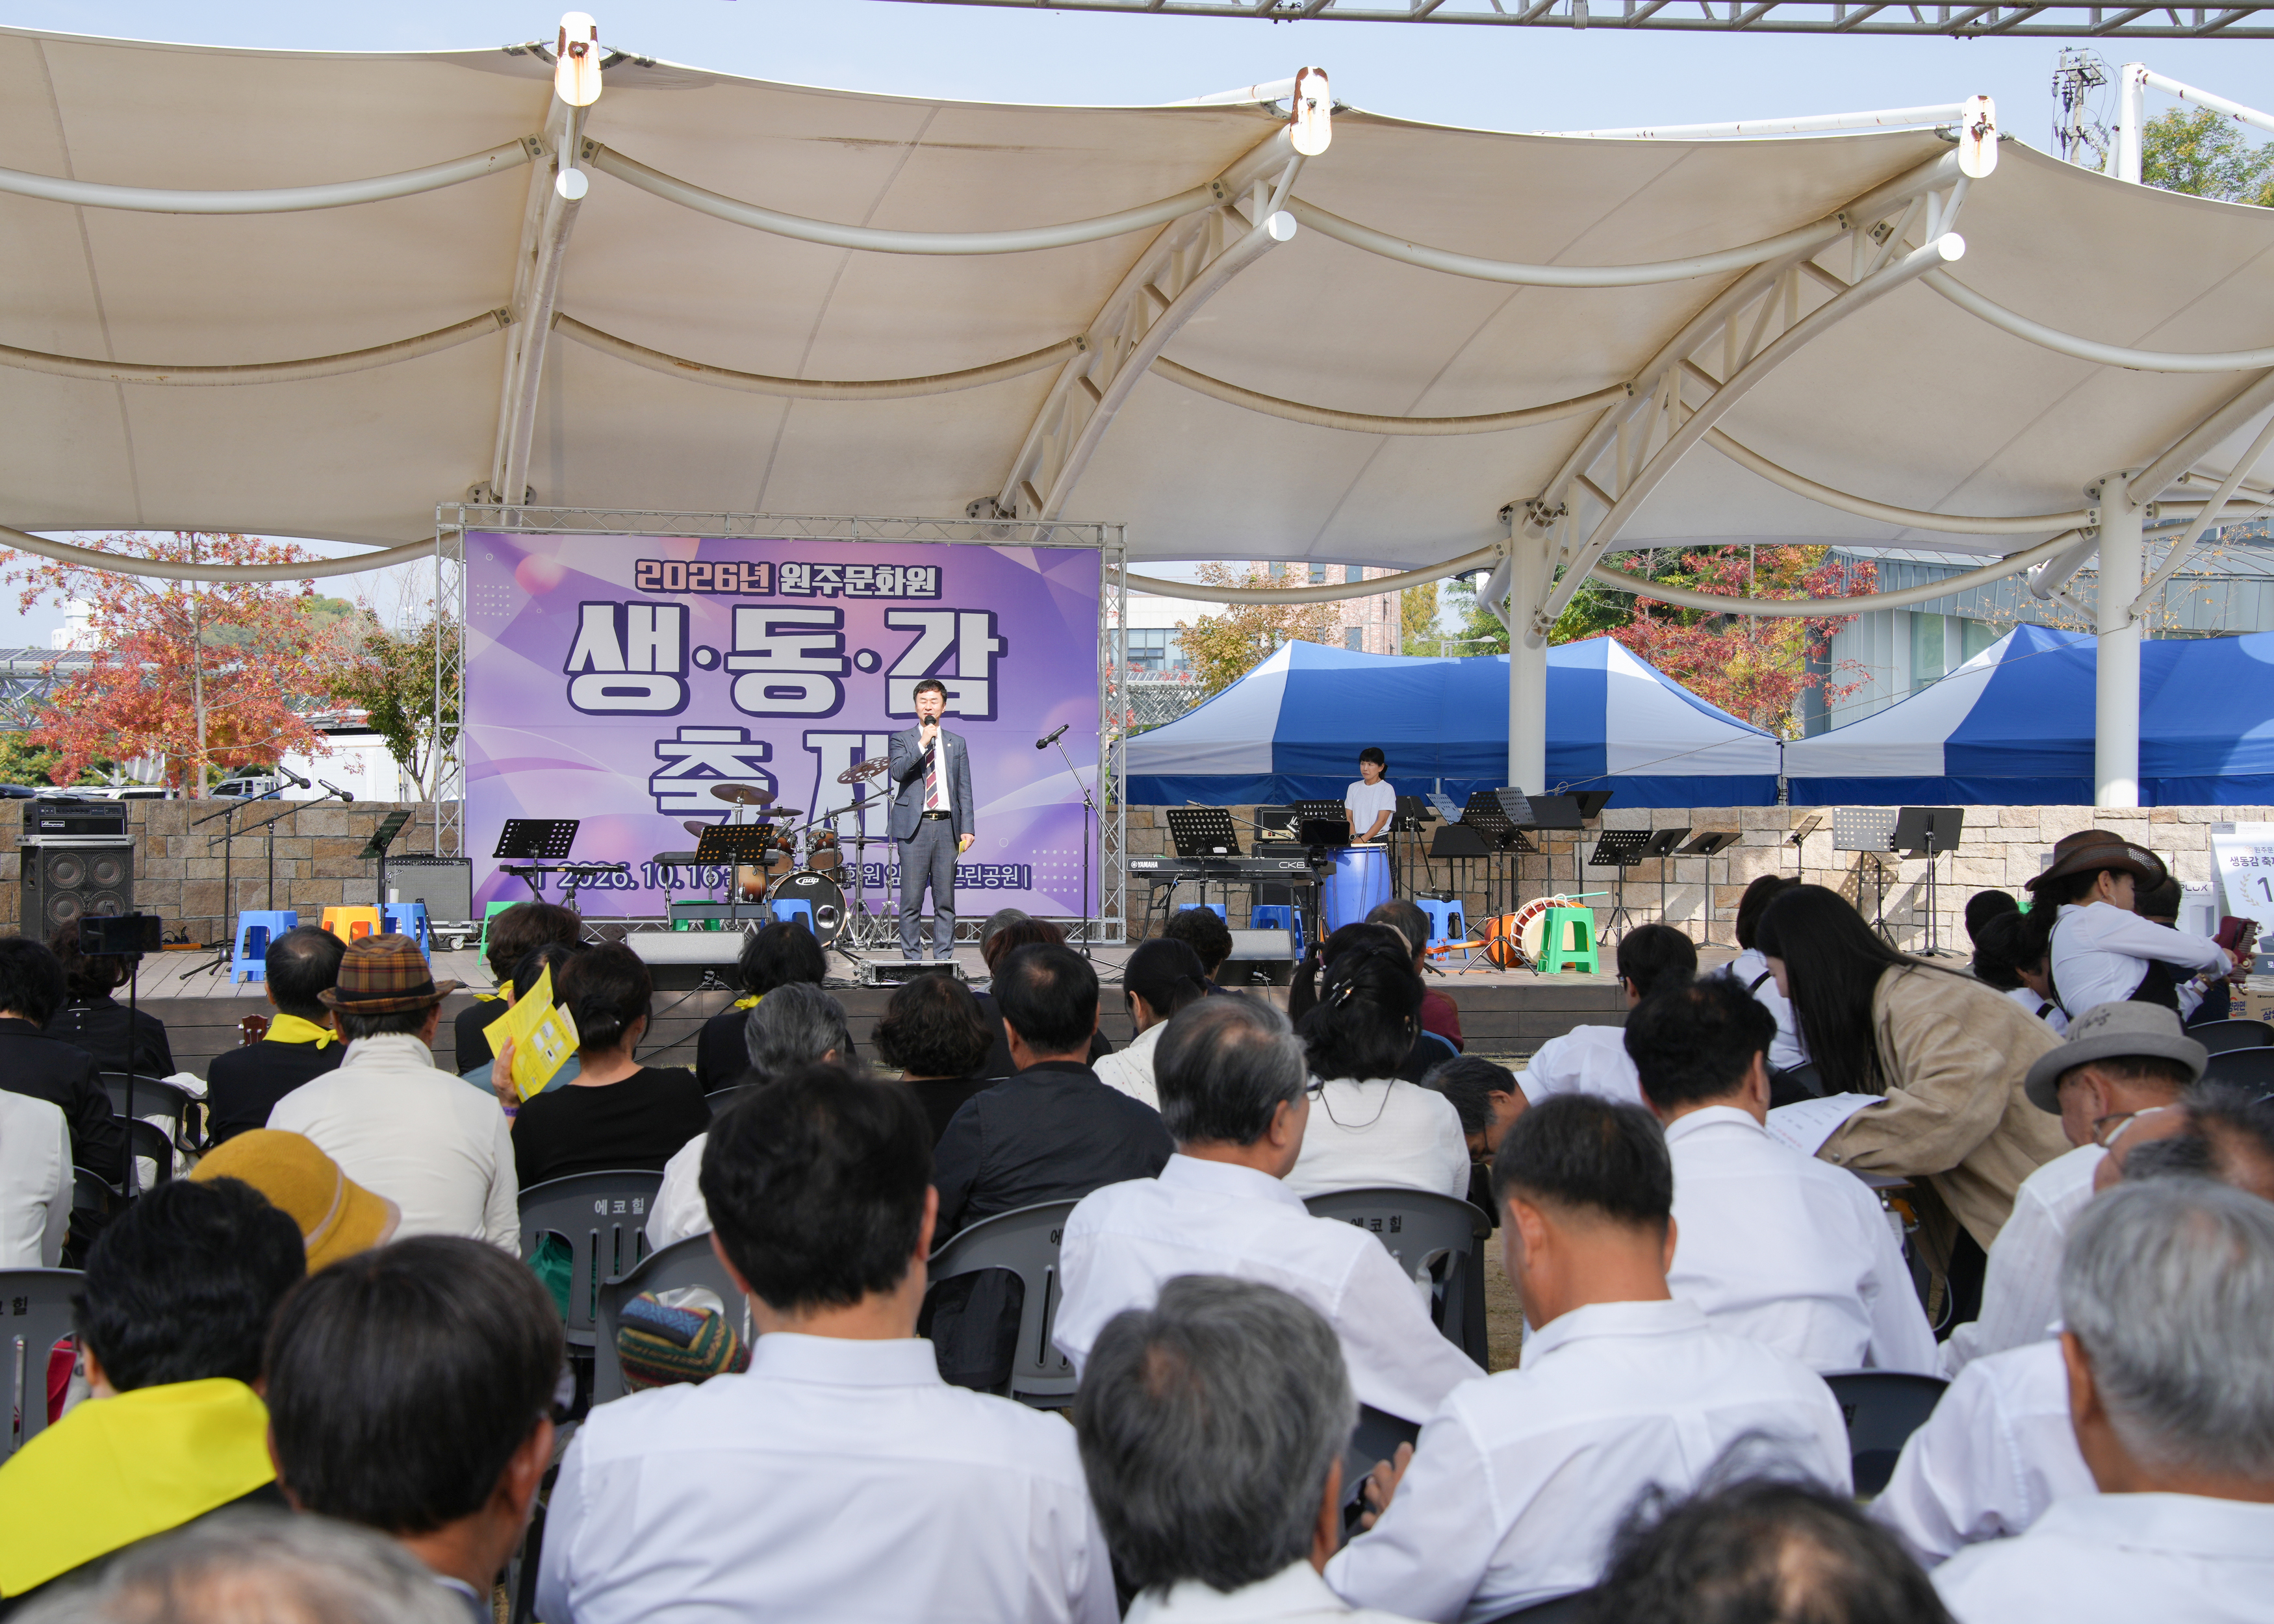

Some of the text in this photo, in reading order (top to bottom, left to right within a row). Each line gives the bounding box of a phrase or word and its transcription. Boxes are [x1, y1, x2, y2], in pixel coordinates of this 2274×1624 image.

[637, 561, 936, 597] 2026년 원주문화원
[2230, 856, 2259, 867] 생동감
[2263, 1011, 2274, 1021] 삼
[594, 1198, 645, 1216] 에코힐
